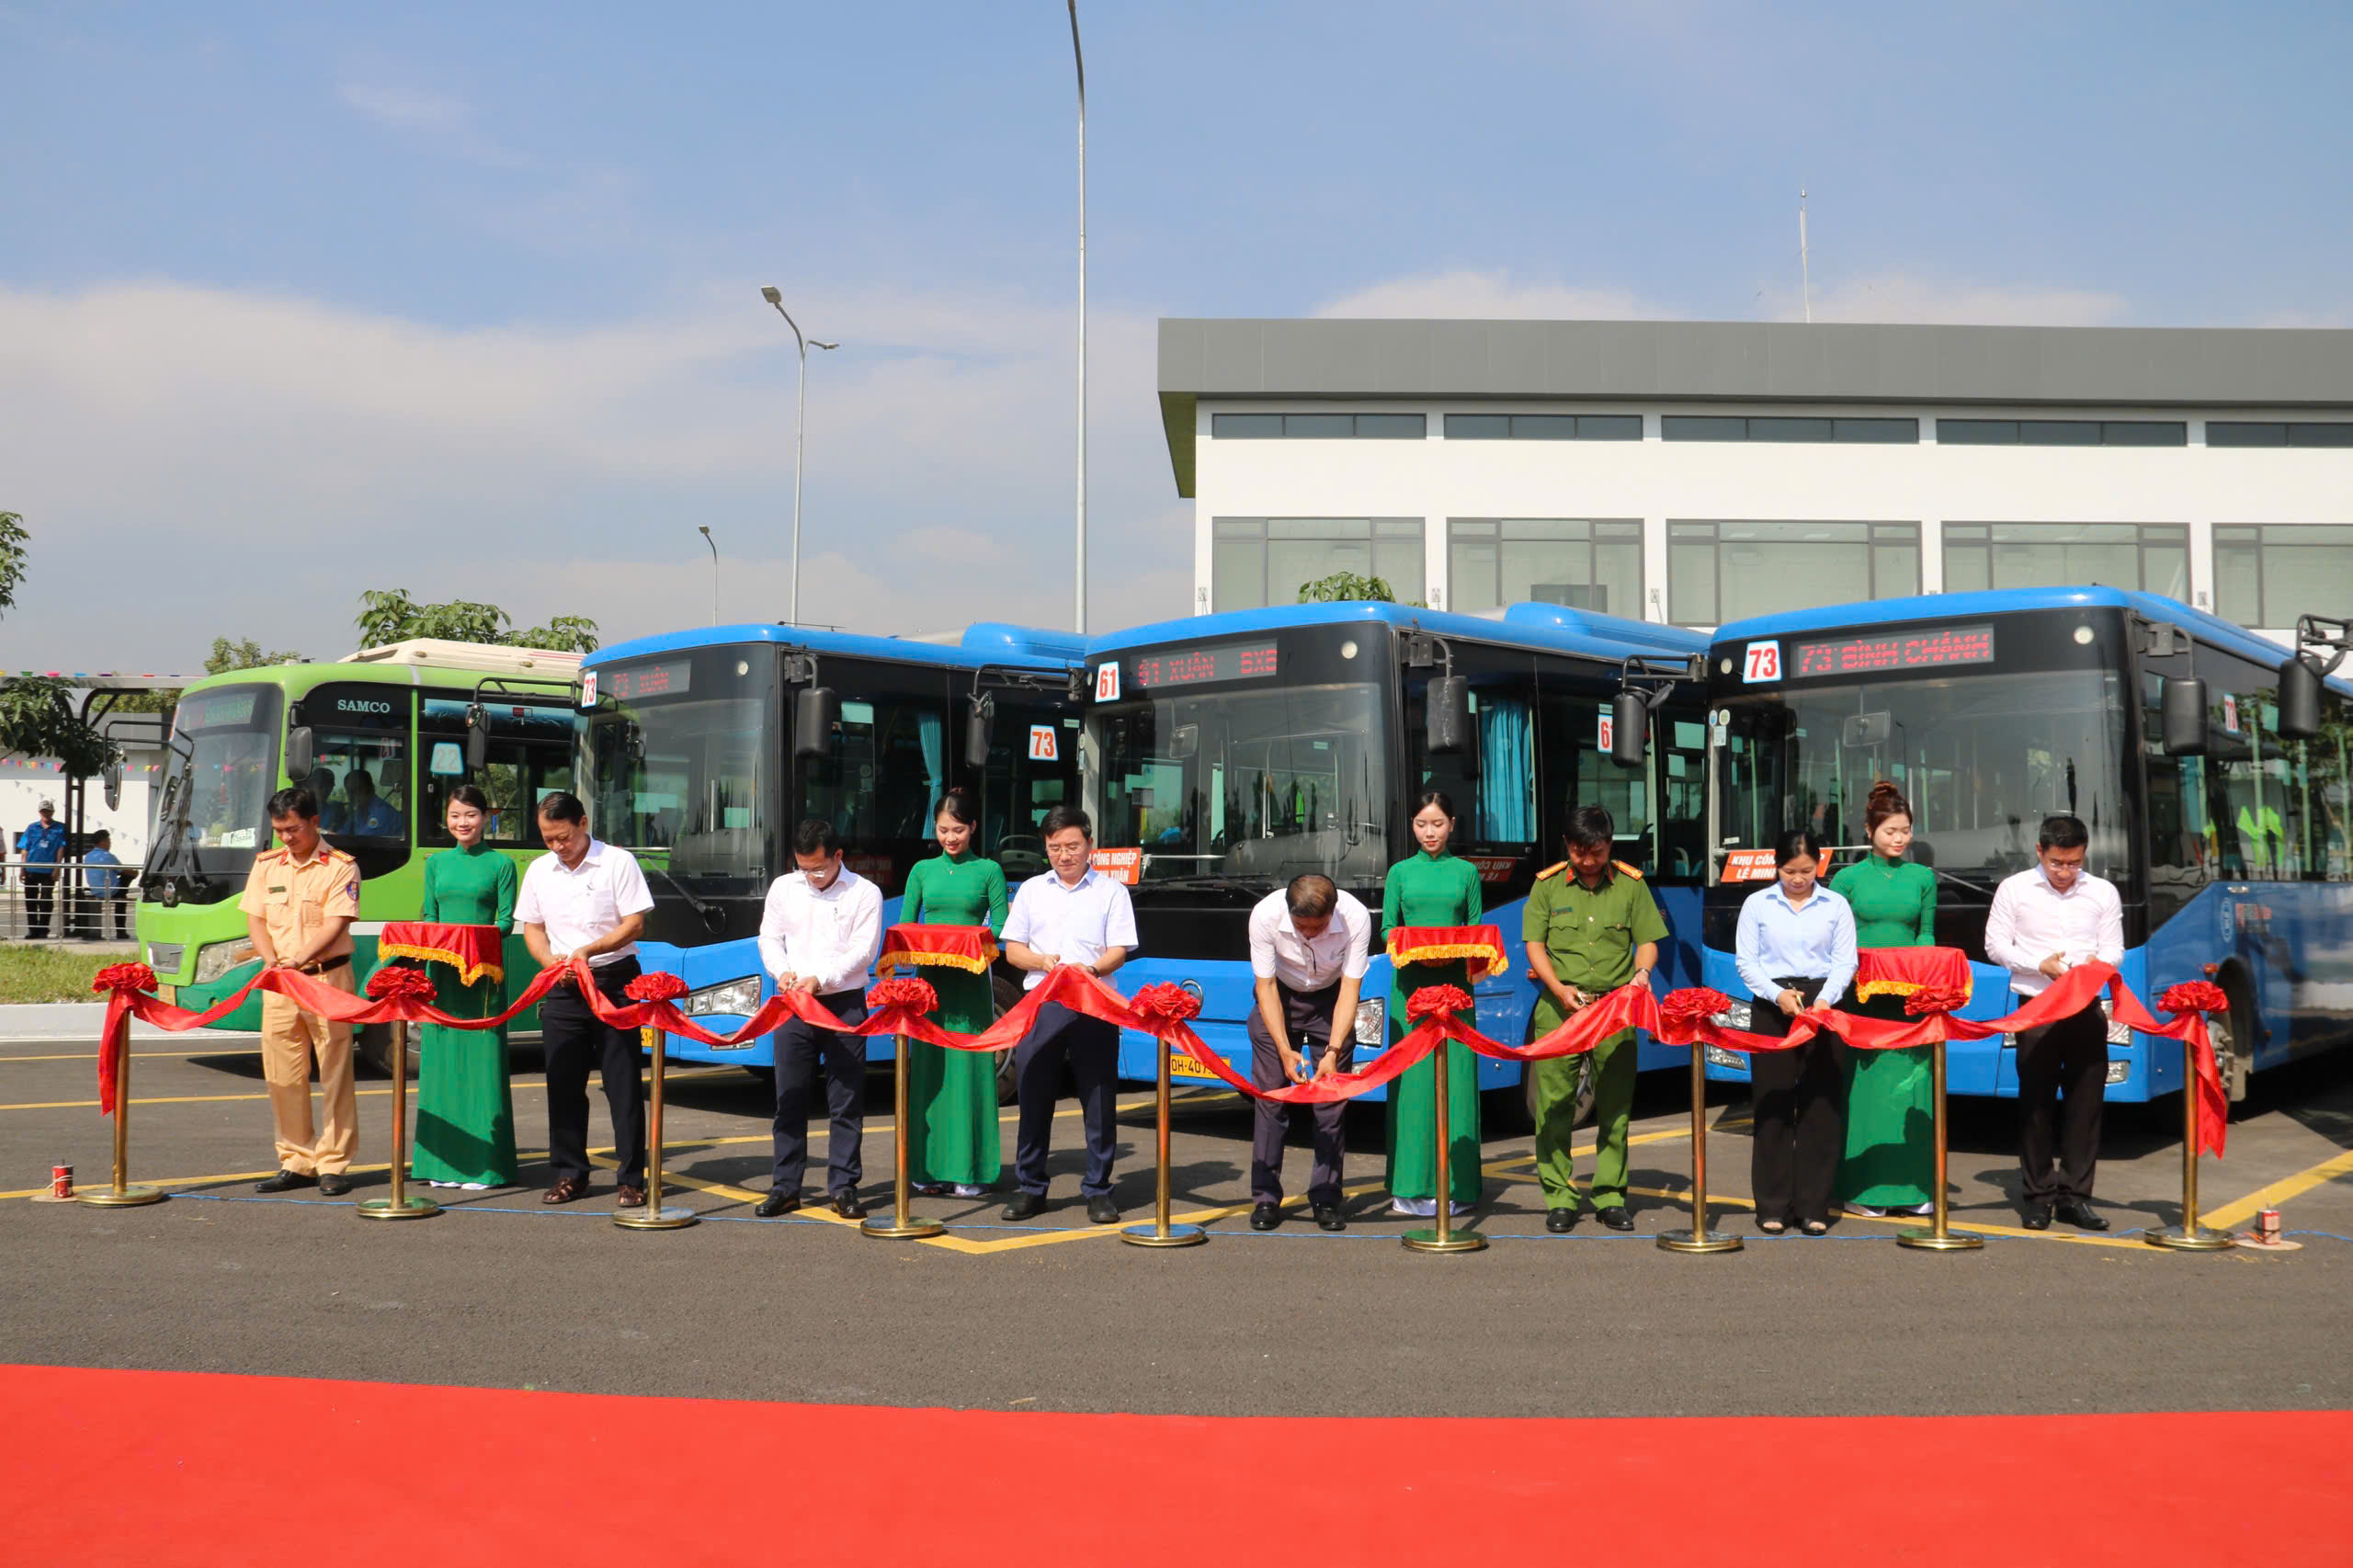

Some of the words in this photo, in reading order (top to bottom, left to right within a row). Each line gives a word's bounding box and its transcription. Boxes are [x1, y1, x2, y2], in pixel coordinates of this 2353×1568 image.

[1748, 648, 1777, 678] 73
[585, 678, 596, 703] 73
[1099, 669, 1117, 698] 61
[337, 699, 391, 713] SAMCO
[1032, 731, 1054, 756] 73
[1600, 722, 1613, 748] 6
[435, 748, 459, 770] 22
[1093, 850, 1110, 865] CÔNG
[1111, 849, 1137, 868] NGHIỆP
[1732, 855, 1754, 866] KHU
[1755, 853, 1776, 866] CÔN
[1736, 867, 1750, 879] LÊ
